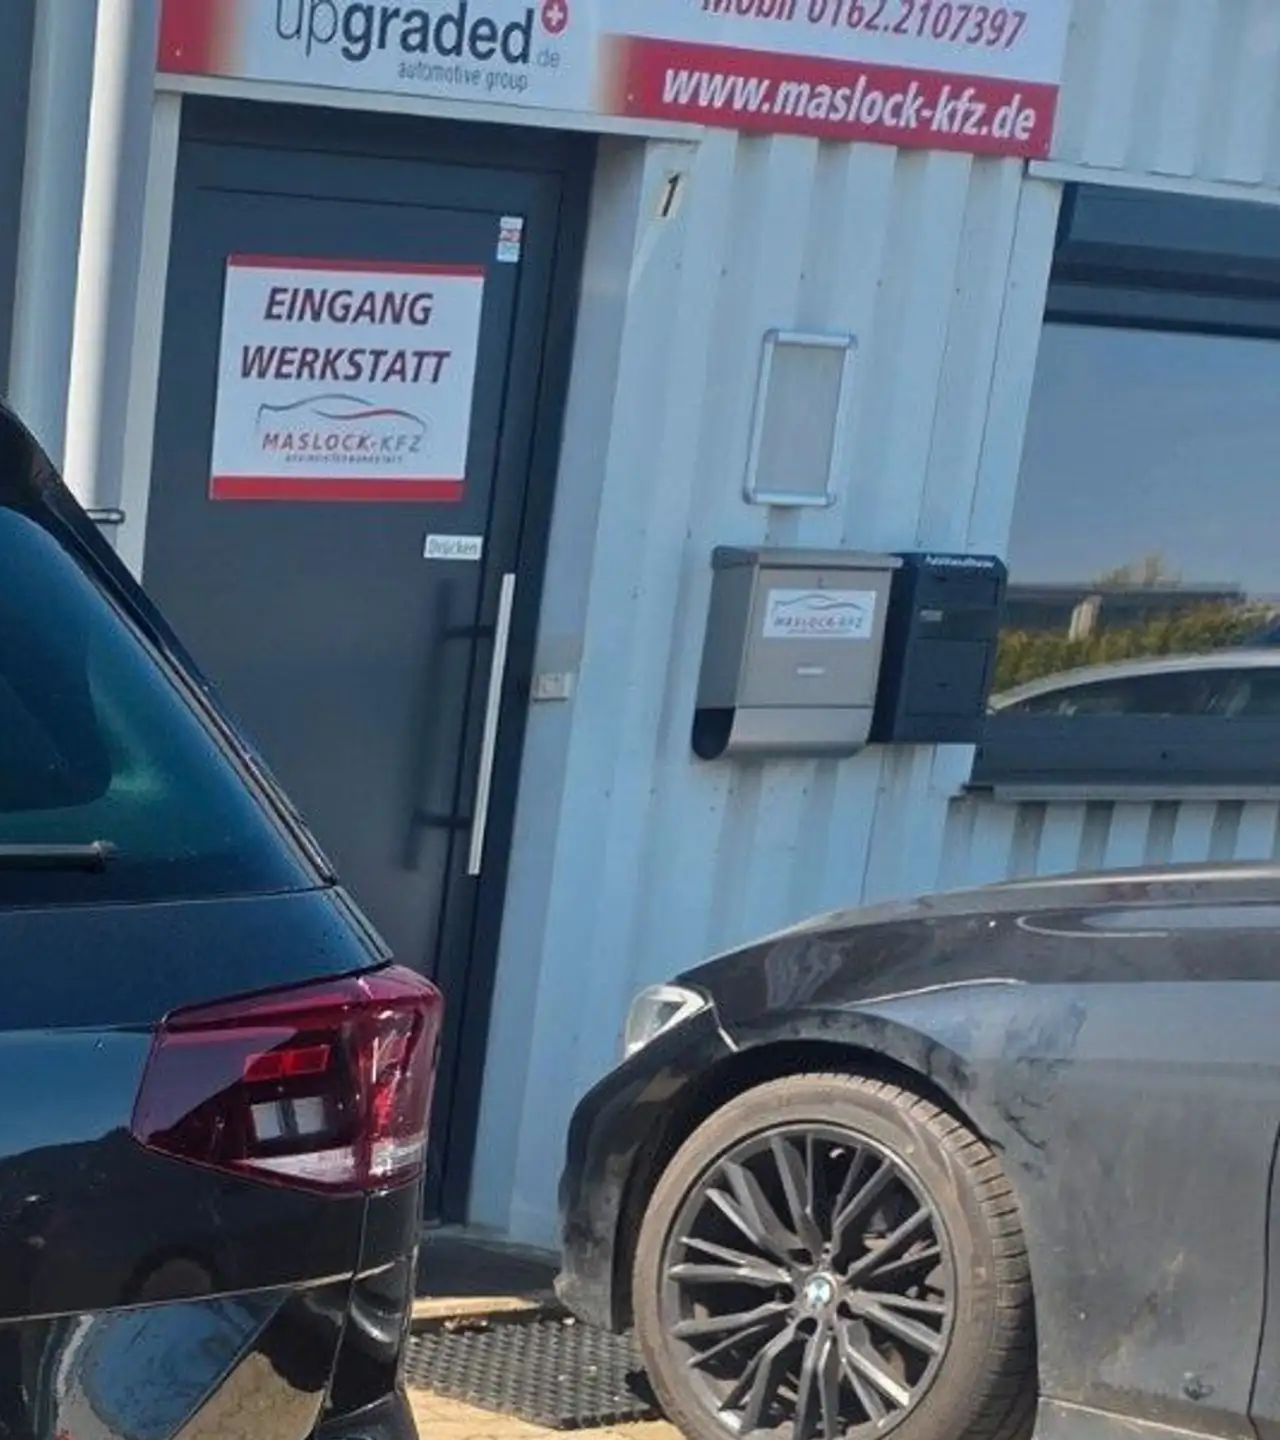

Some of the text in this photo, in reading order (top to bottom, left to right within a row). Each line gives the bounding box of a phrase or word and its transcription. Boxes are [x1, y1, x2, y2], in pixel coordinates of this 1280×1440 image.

[276, 0, 535, 64] upgraded
[808, 0, 1028, 49] 0162.2107397
[397, 60, 528, 93] automotive group
[663, 67, 1037, 142] www.maslock-kfz.de
[263, 285, 434, 326] EINGANG
[240, 344, 452, 384] WERKSTATT
[261, 432, 423, 453] MASLOCK-KFZ
